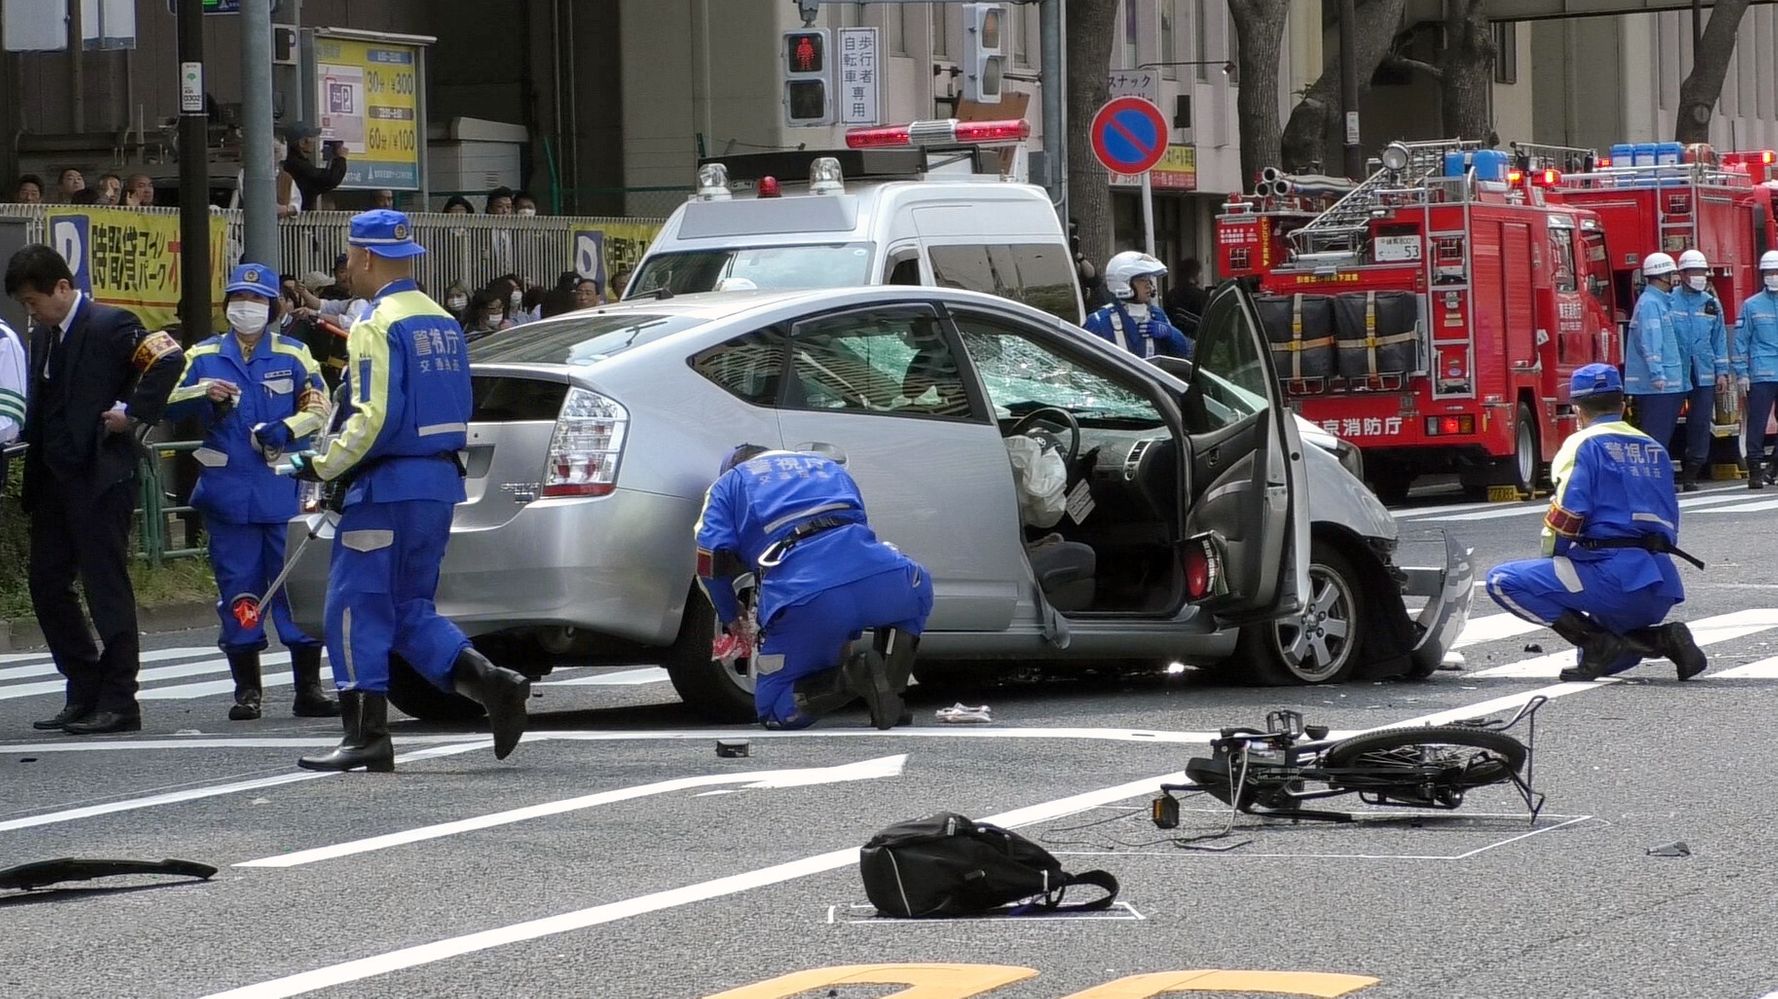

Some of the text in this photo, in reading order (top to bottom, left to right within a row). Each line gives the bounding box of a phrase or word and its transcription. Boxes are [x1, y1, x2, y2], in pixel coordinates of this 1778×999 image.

[843, 36, 857, 83] 自転車
[859, 35, 873, 84] 歩行者
[1106, 74, 1151, 88] スナック
[851, 86, 866, 117] 専用
[91, 223, 139, 292] 時間貸
[139, 231, 166, 259] コイン
[139, 260, 166, 292] パーク
[412, 328, 460, 356] 警視庁
[1311, 416, 1403, 437] 京消防庁
[1603, 441, 1663, 465] 警視庁
